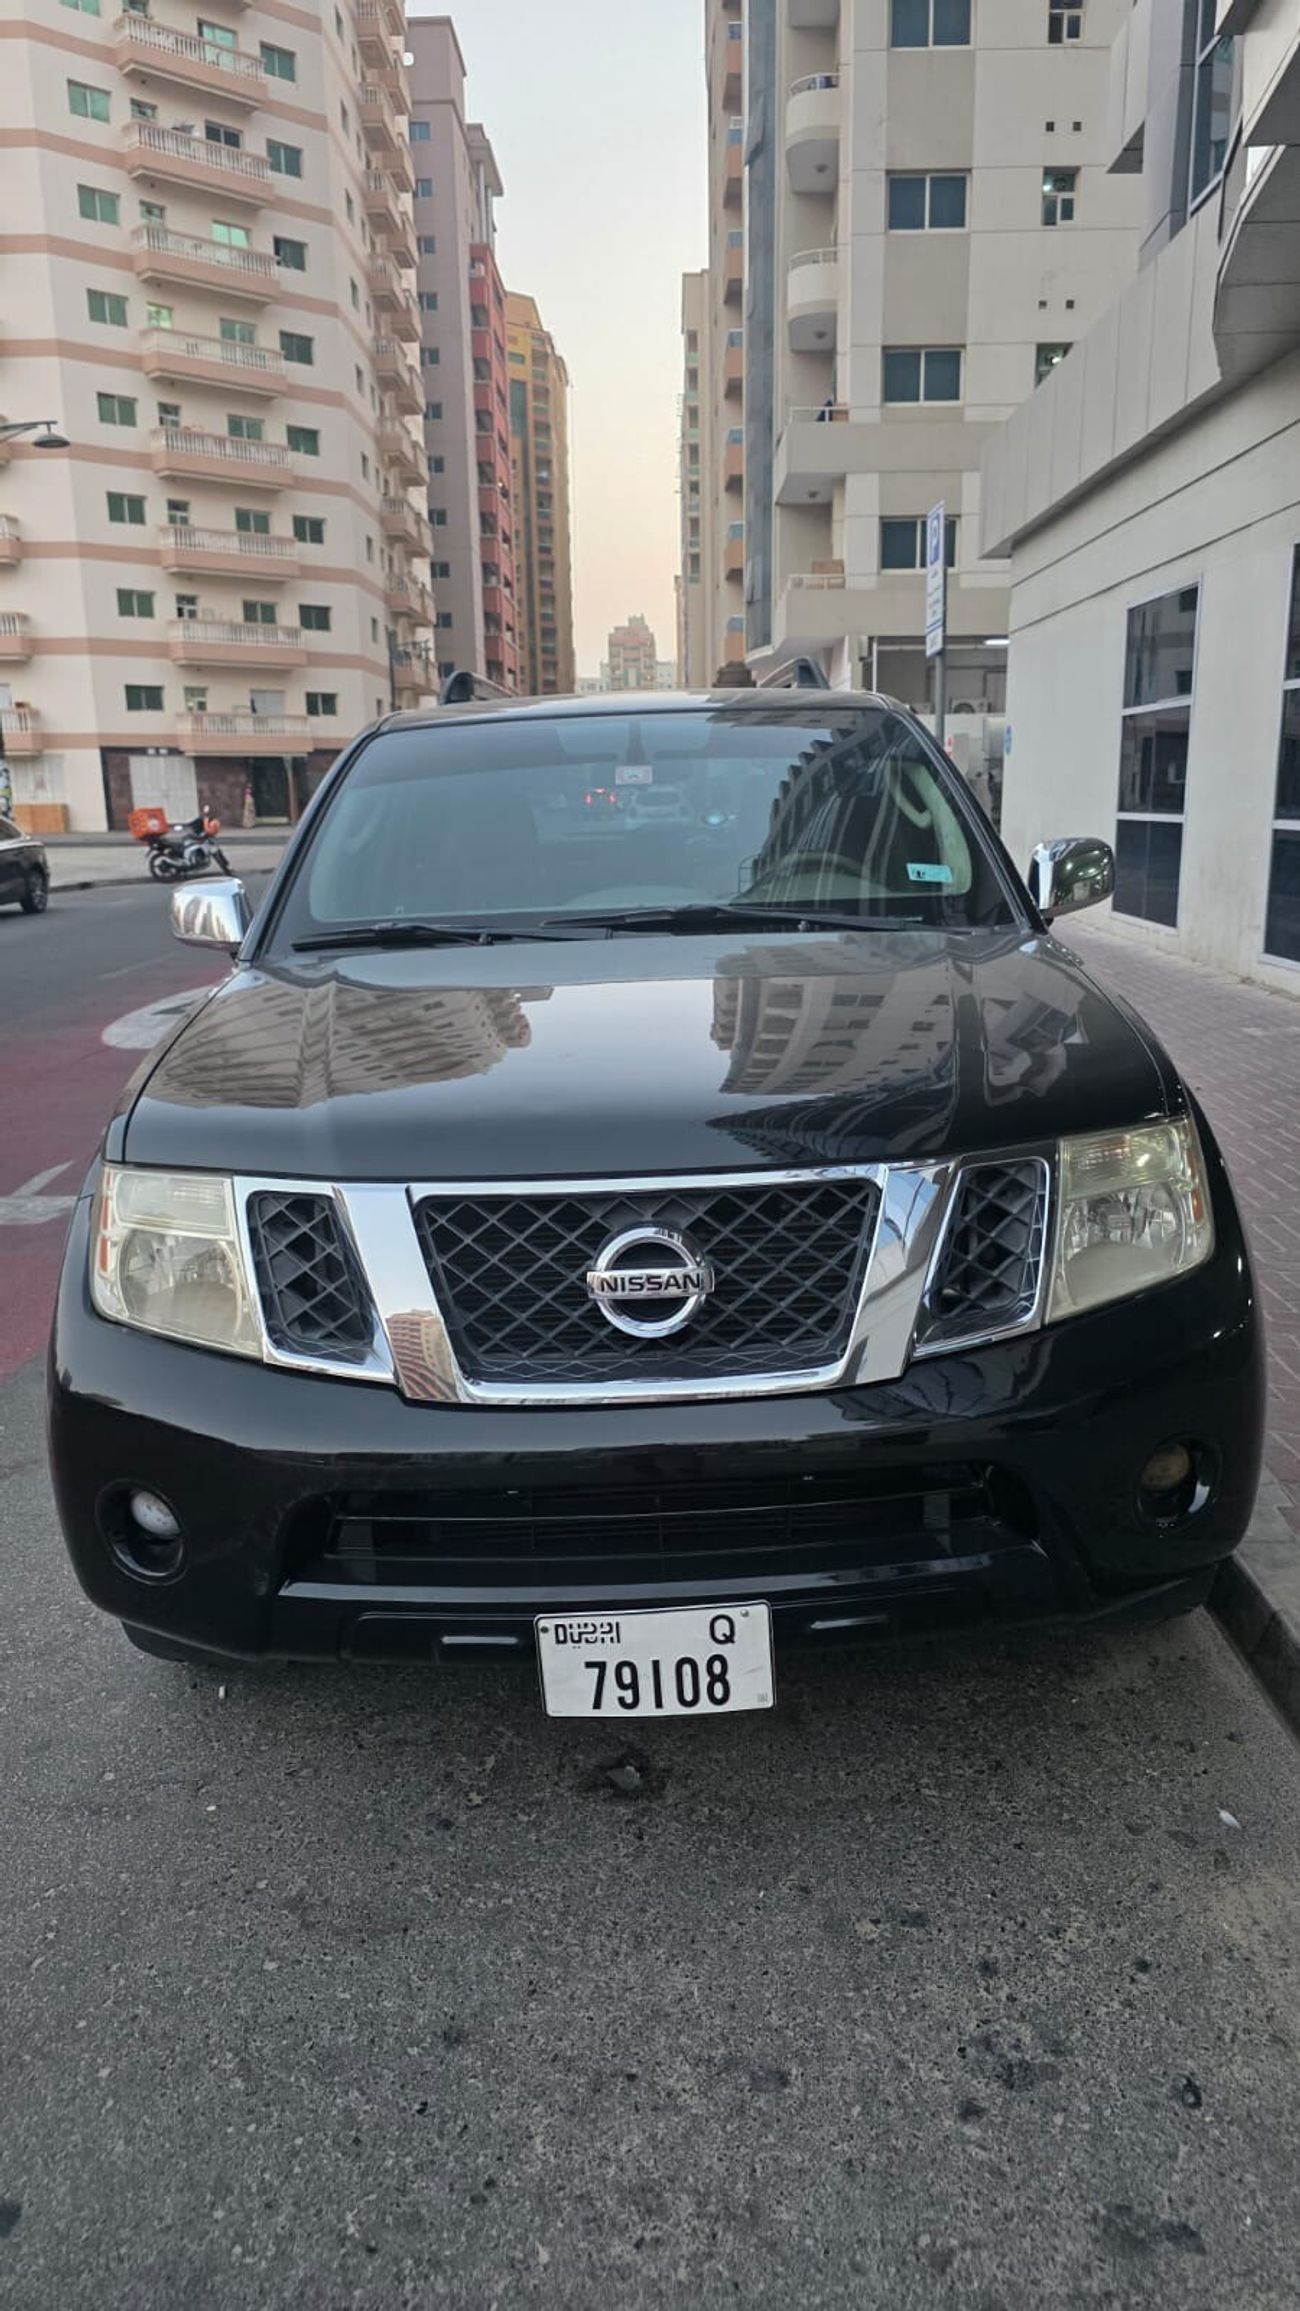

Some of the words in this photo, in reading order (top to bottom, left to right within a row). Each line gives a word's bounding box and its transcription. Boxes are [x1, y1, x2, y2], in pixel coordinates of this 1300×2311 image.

[600, 1273, 701, 1293] NISSAN
[709, 1614, 736, 1645] Q
[584, 1653, 731, 1710] 79108
